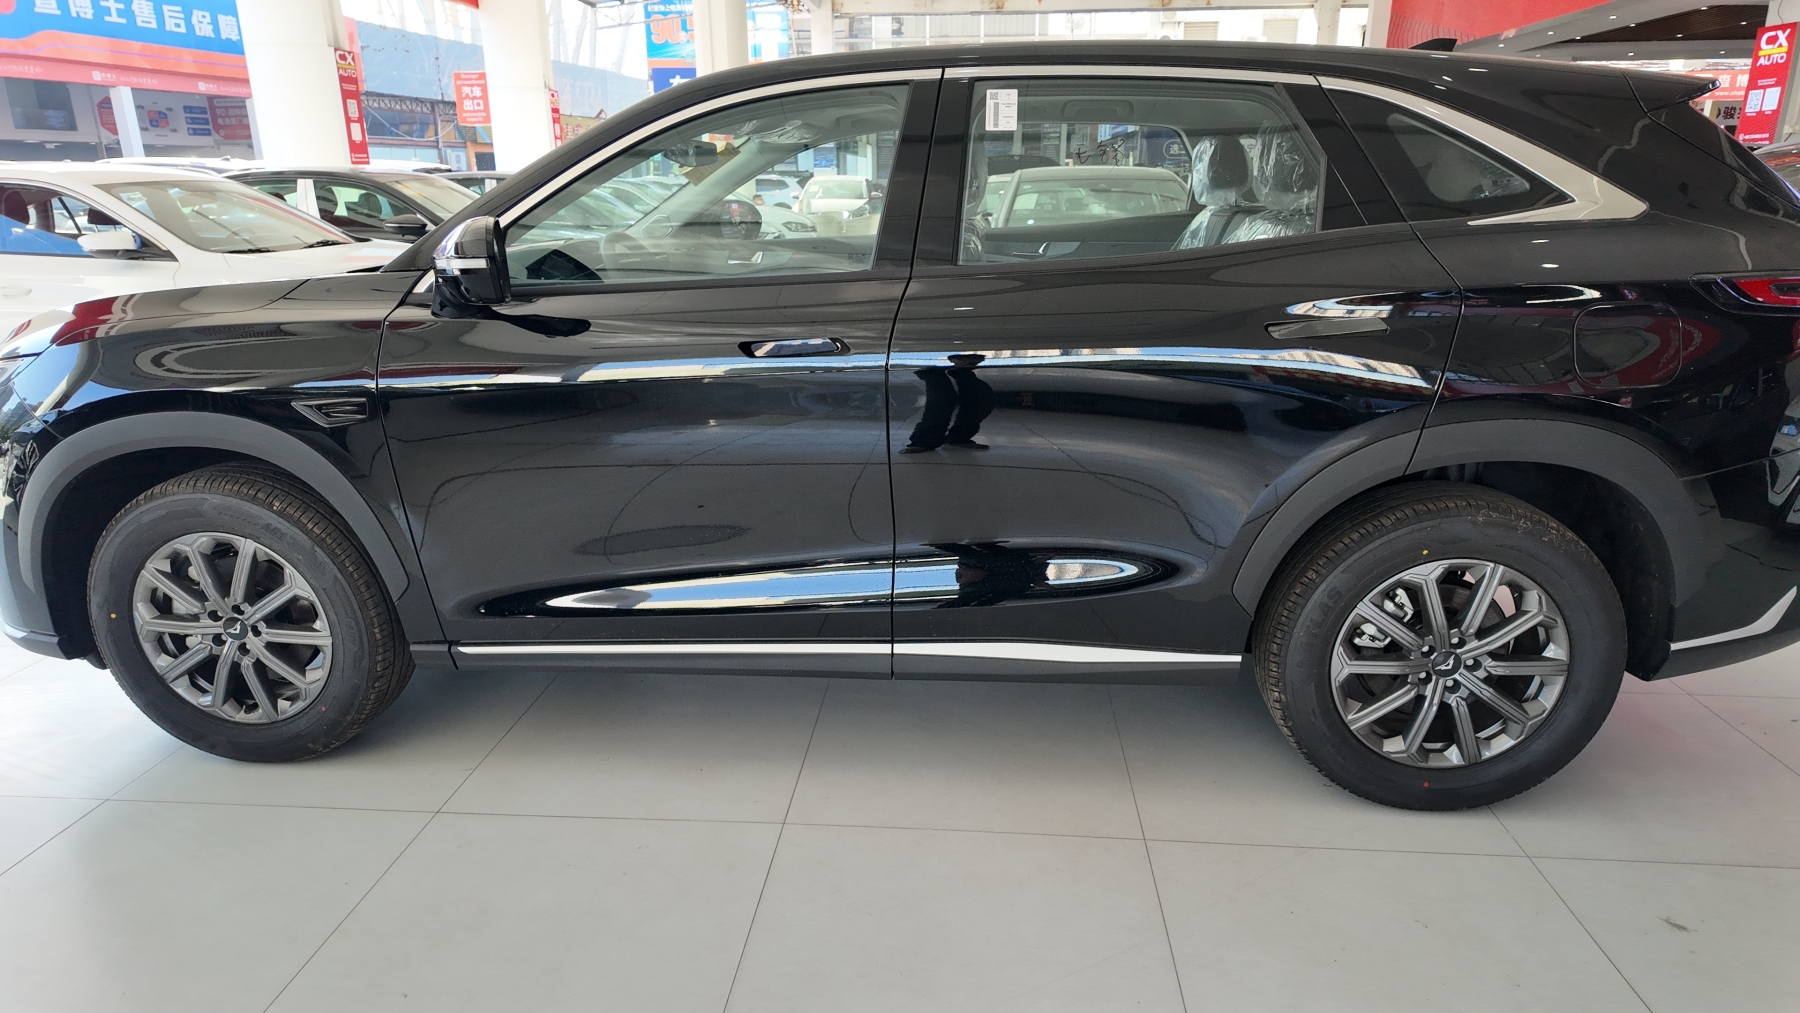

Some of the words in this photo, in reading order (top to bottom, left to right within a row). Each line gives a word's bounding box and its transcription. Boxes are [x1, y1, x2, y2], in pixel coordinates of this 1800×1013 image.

[1760, 28, 1791, 50] CX
[335, 50, 355, 66] CX
[1756, 52, 1787, 67] AUTO
[338, 68, 357, 78] AUTO
[461, 85, 483, 98] 汽车
[463, 98, 484, 111] 出口
